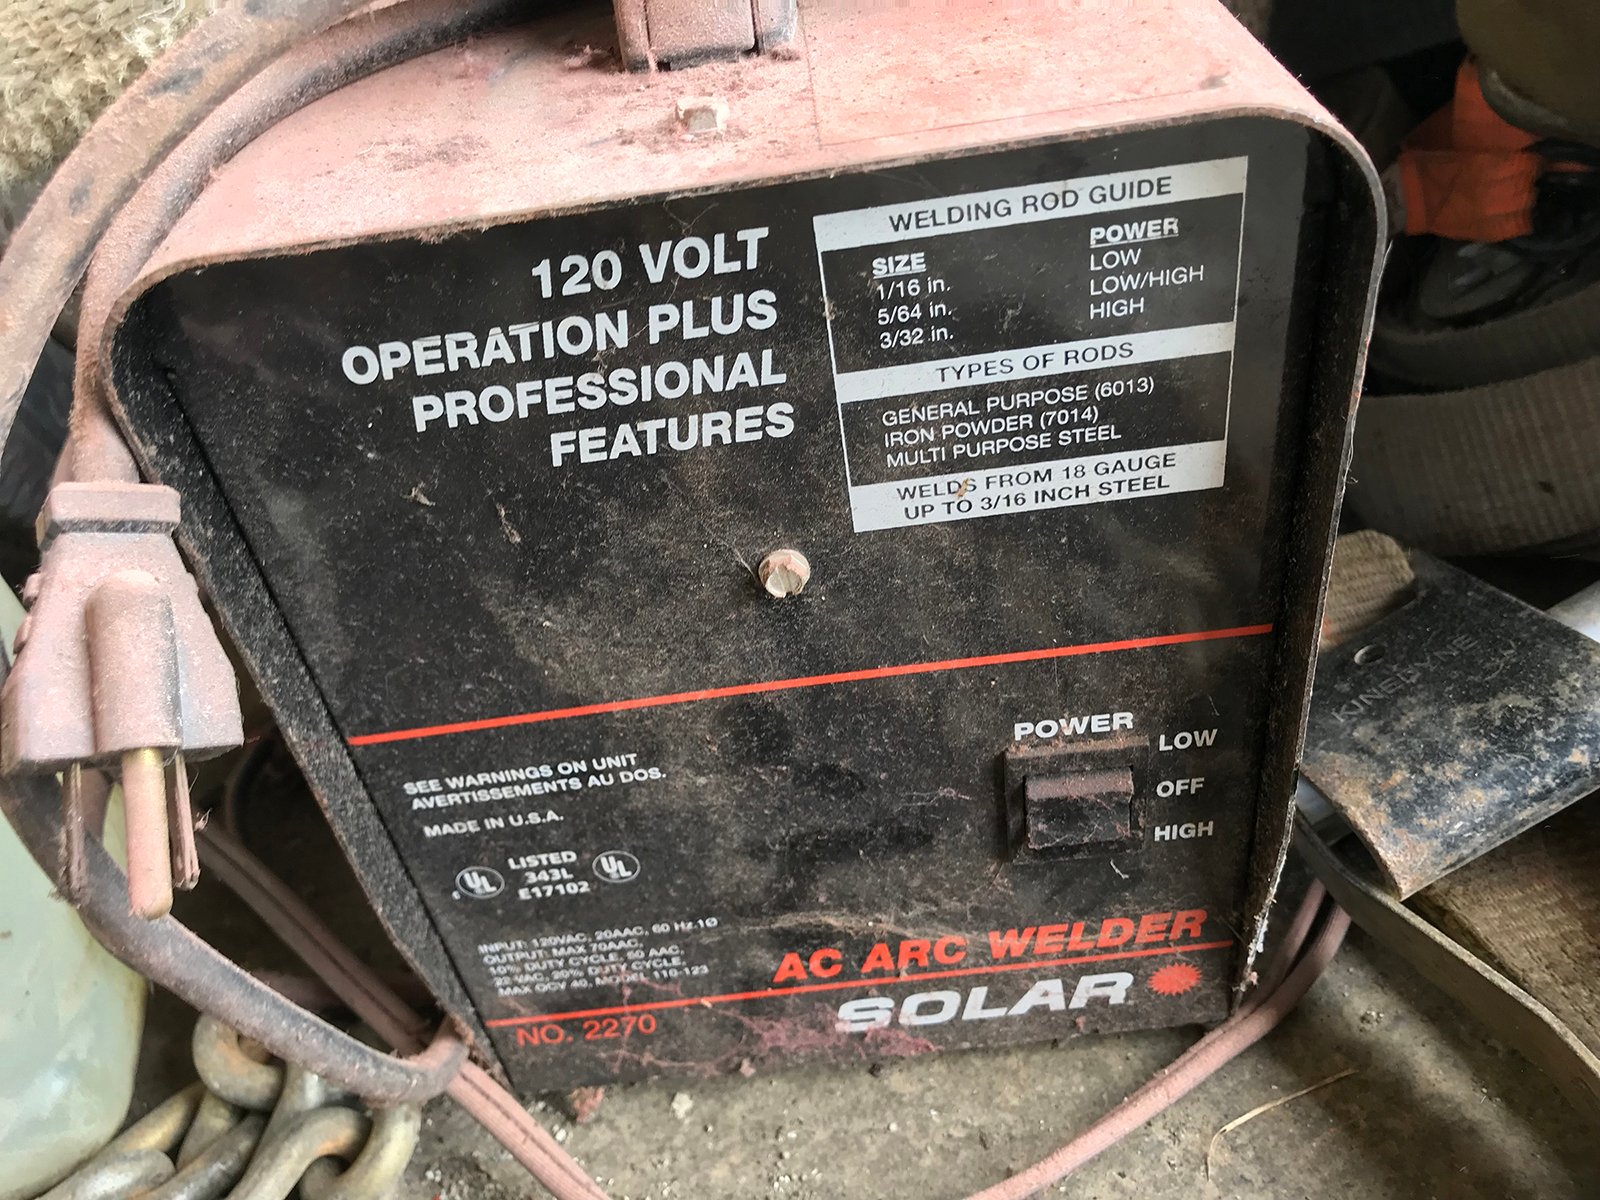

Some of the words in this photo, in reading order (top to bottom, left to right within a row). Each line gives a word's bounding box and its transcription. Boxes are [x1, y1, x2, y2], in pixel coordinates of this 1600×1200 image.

[889, 200, 1012, 232] WELDING
[1022, 190, 1079, 214] ROD
[1089, 176, 1173, 203] GUIDE
[1090, 217, 1179, 245] POWER
[532, 250, 622, 298] 120
[639, 227, 769, 284] VOLT
[872, 252, 926, 276] SIZE
[1090, 248, 1142, 271] LOW
[877, 279, 921, 300] 1/16
[927, 276, 952, 294] in.
[1090, 265, 1204, 296] LOW/HIGH
[877, 303, 922, 325] 5/64
[929, 301, 953, 319] in.
[1090, 298, 1146, 320] HIGH
[342, 309, 629, 385] OPERATION
[648, 289, 778, 344] PLUS
[880, 327, 923, 350] 3/32
[930, 324, 954, 342] in.
[936, 359, 1014, 383] TYPES
[1023, 352, 1056, 372] OF
[1063, 342, 1135, 366] RODS
[412, 349, 787, 432] PROFESSIONAL
[882, 400, 980, 427] GENERAL
[986, 384, 1089, 413] PURPOSE
[1095, 376, 1155, 402] (6013)
[550, 402, 795, 468] FEATURES
[884, 427, 935, 448] IRON
[941, 413, 1033, 441] POWDER
[1039, 405, 1100, 431] (7014)
[886, 447, 946, 468] MULTI
[952, 433, 1052, 460] PURPOSE
[1058, 424, 1122, 446] STEEL
[896, 477, 977, 500] WELDS
[985, 467, 1053, 490] FROM
[1062, 464, 1086, 480] 18
[1094, 452, 1177, 476] GAUGE
[904, 502, 936, 521] UP
[941, 498, 973, 517] TO
[980, 491, 1027, 511] 3/16
[1034, 483, 1091, 505] INCH
[1097, 474, 1170, 497] STEEL
[1014, 711, 1133, 741] POWER
[1159, 729, 1218, 751] LOW
[403, 779, 443, 795] SEE
[445, 763, 553, 790] WARNINGS
[557, 759, 588, 775] ON
[592, 753, 638, 771] UNIT
[411, 777, 582, 810] AVERTISSEMENTS
[587, 773, 614, 788] AU
[620, 766, 667, 783] DOS.
[1155, 777, 1205, 797] OFF
[423, 820, 481, 838] MADE
[484, 816, 505, 830] IN
[508, 810, 564, 827] U.S.A.
[1154, 821, 1214, 841] HIGH
[507, 851, 577, 870] LISTED
[518, 881, 590, 900] E17102
[524, 868, 574, 884] 343L
[552, 944, 586, 957] MAX
[773, 948, 842, 983] AC
[861, 935, 967, 974] ARC
[988, 908, 1208, 959] WELDER
[524, 958, 564, 972] DUTY
[498, 985, 533, 996] MAX
[835, 971, 1135, 1032] SOLAR
[516, 1022, 574, 1047] NO.
[582, 1014, 657, 1041] 2270
